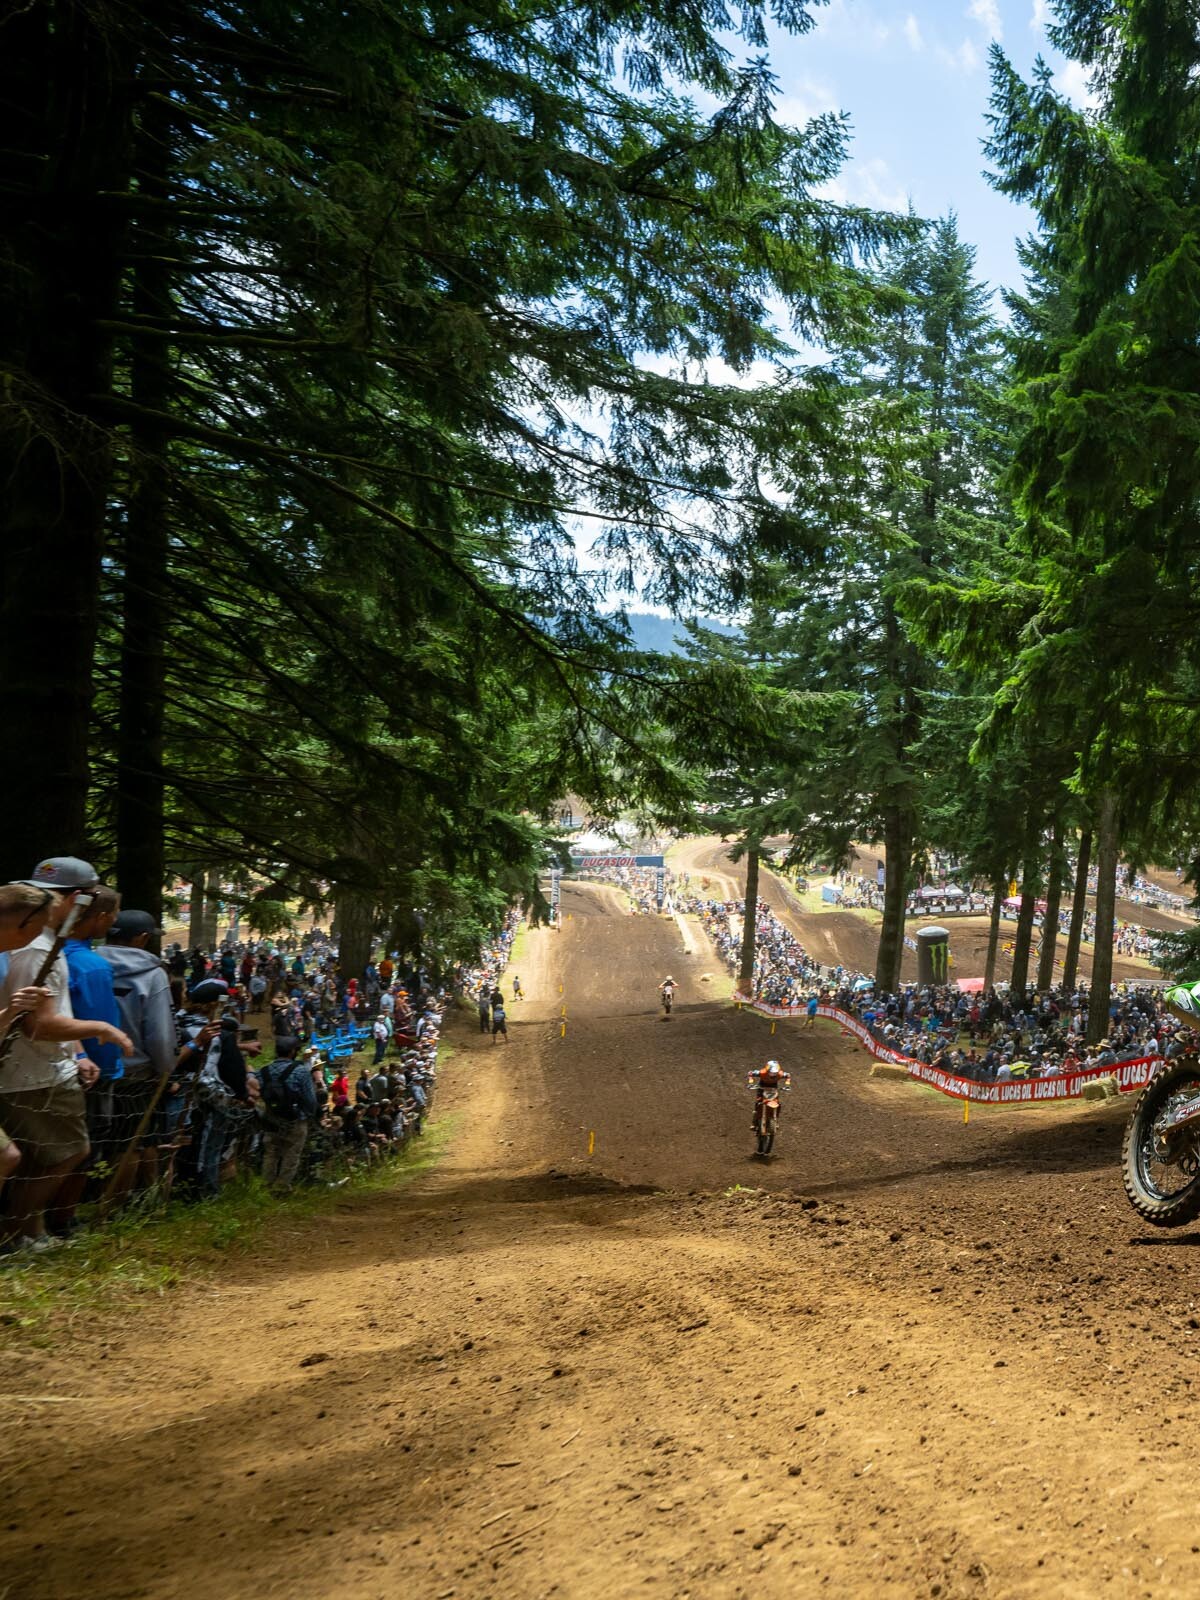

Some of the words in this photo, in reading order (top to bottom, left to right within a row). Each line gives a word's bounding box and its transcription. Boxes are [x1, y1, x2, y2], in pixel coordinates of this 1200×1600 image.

[582, 857, 618, 867] LUCAS
[619, 857, 637, 866] OIL
[1116, 1062, 1148, 1086] LUCAS
[1001, 1084, 1021, 1100] LUCAS
[1022, 1083, 1032, 1099] OIL
[1034, 1080, 1056, 1098] LUCAS
[1056, 1079, 1068, 1096] OIL
